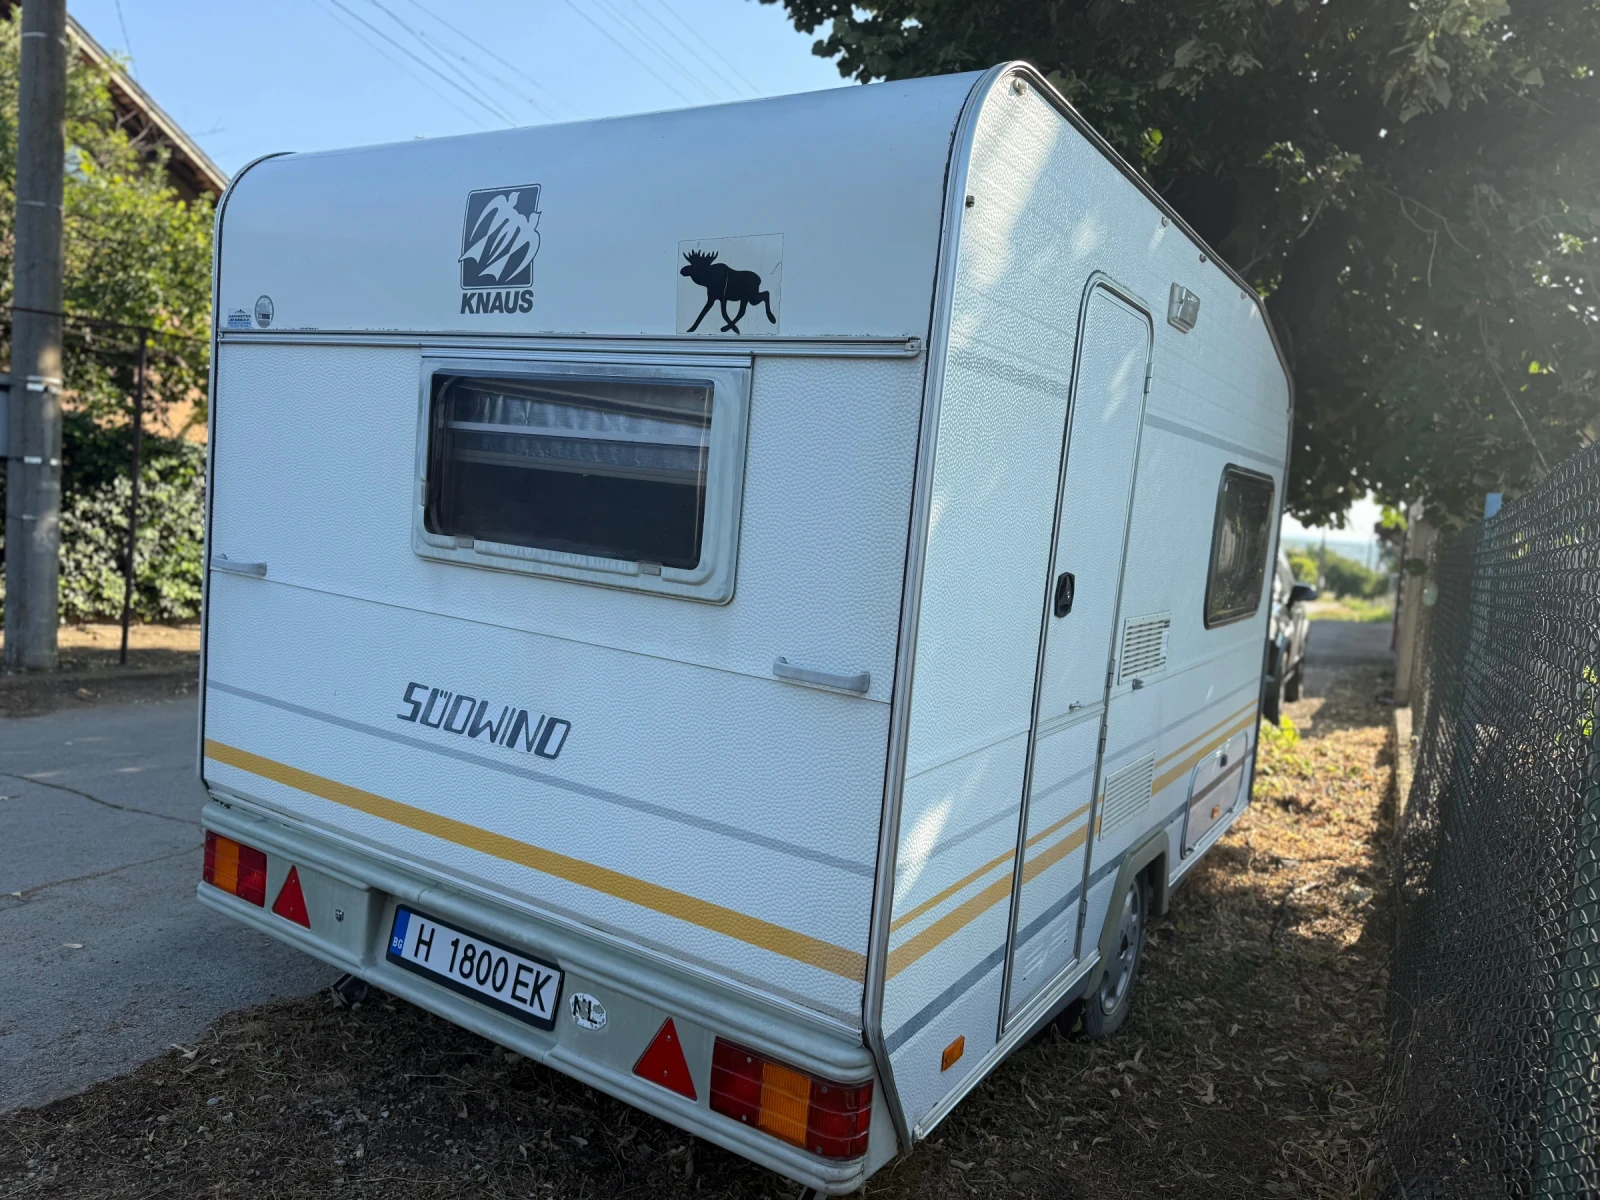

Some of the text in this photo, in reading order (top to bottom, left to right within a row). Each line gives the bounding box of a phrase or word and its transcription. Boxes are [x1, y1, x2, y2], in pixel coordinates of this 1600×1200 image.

[460, 289, 534, 315] KNAUS
[396, 681, 572, 760] SÜDWIND
[392, 936, 404, 950] BG
[413, 923, 553, 1013] H 1800 EK
[573, 995, 598, 1025] NL
